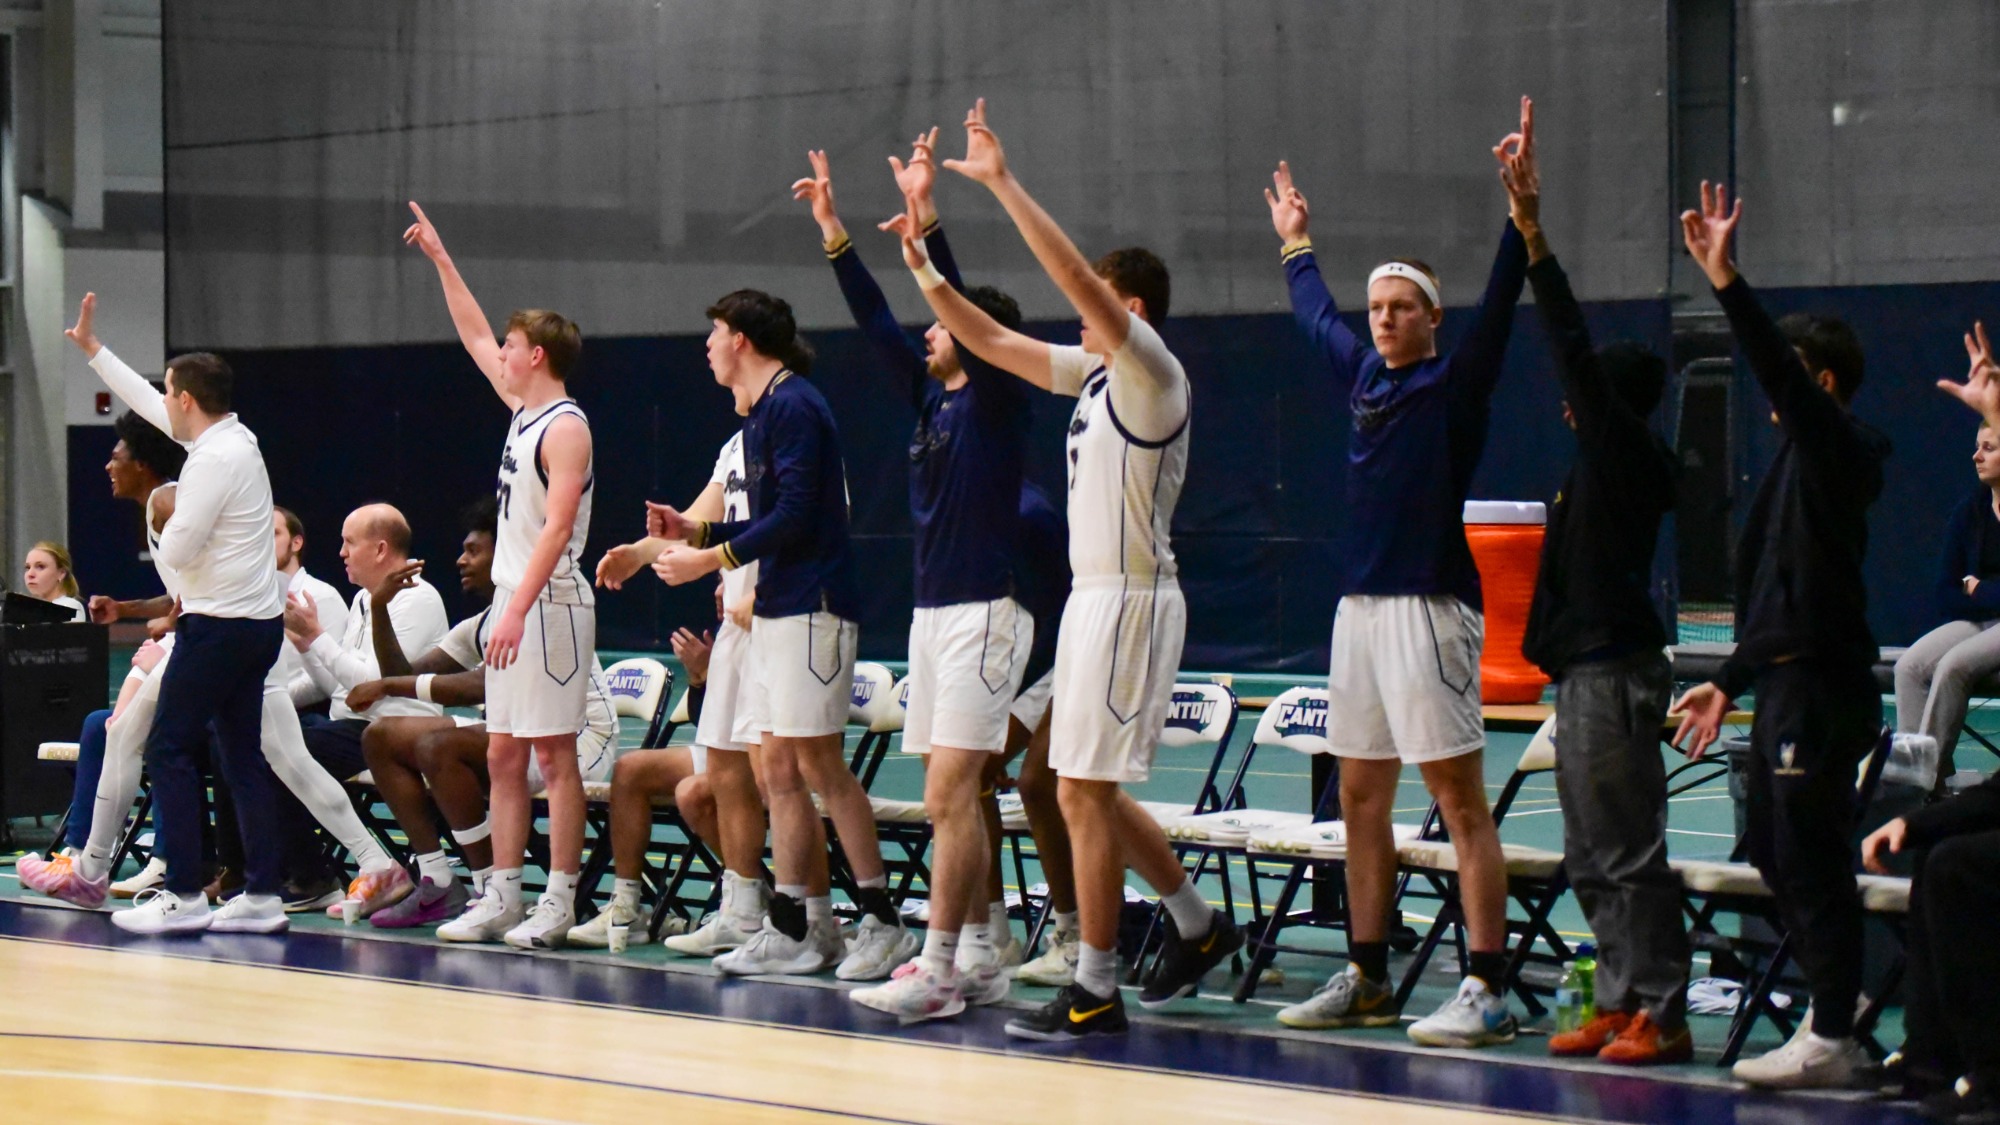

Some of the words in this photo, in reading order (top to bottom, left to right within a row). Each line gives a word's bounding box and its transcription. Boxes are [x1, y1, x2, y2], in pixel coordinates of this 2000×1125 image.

[606, 674, 650, 693] CANTON
[1166, 701, 1217, 724] NTON
[1304, 699, 1326, 707] SUN
[1274, 704, 1328, 728] CANT
